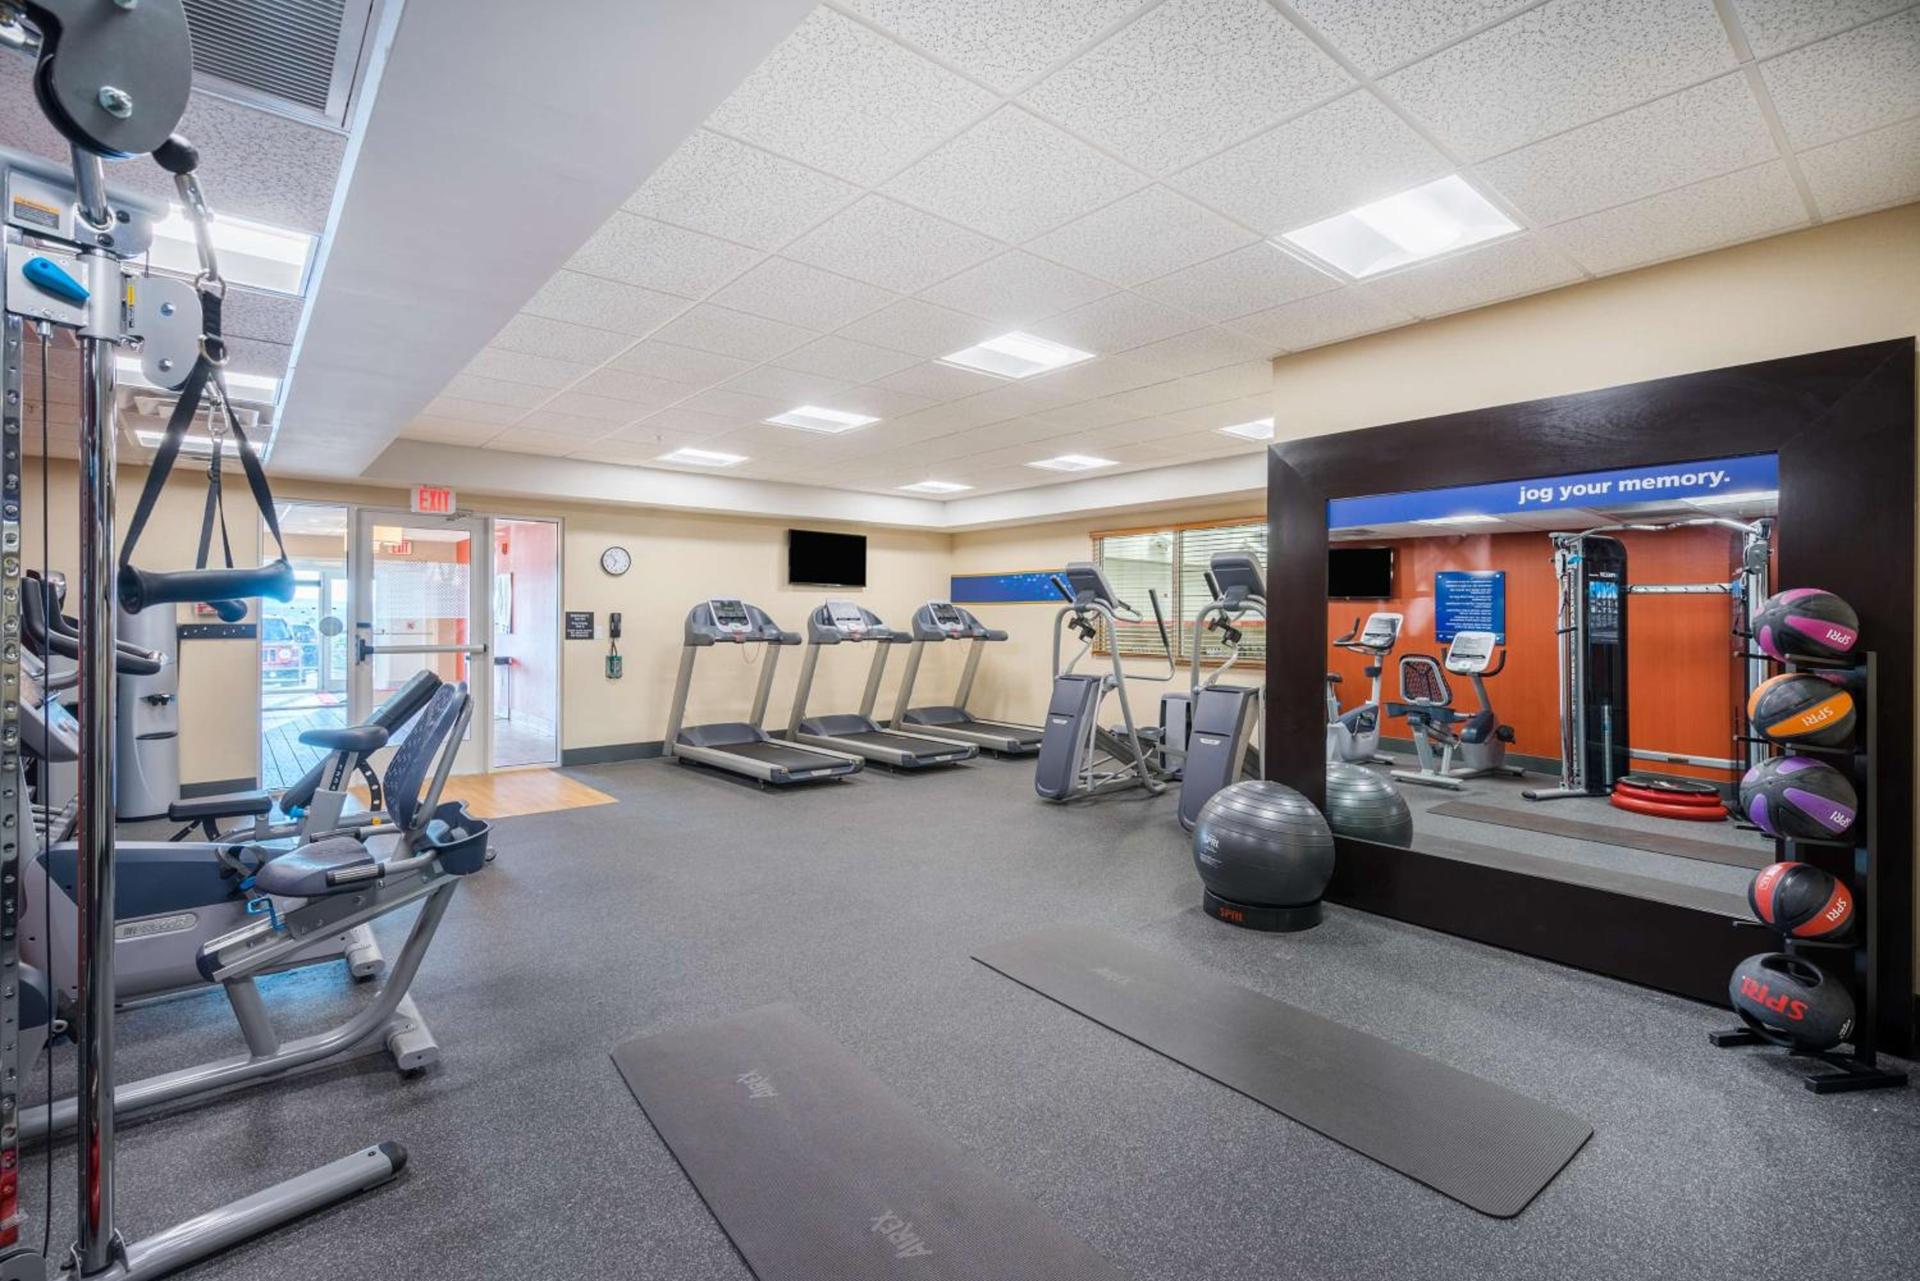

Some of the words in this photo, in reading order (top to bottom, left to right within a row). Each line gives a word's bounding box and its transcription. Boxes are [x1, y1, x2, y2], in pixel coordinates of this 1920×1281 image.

[419, 487, 450, 512] EXIT
[1518, 486, 1553, 504] jog
[1560, 480, 1612, 499] your
[1618, 470, 1731, 492] memory.
[1825, 628, 1852, 645] SPRI
[1801, 706, 1834, 727] SPRI
[1830, 810, 1851, 828] SPRI
[1219, 906, 1243, 922] SPRI
[1826, 897, 1847, 922] SPRI
[1740, 975, 1809, 1021] SPRI
[869, 1208, 932, 1259] AIREX
